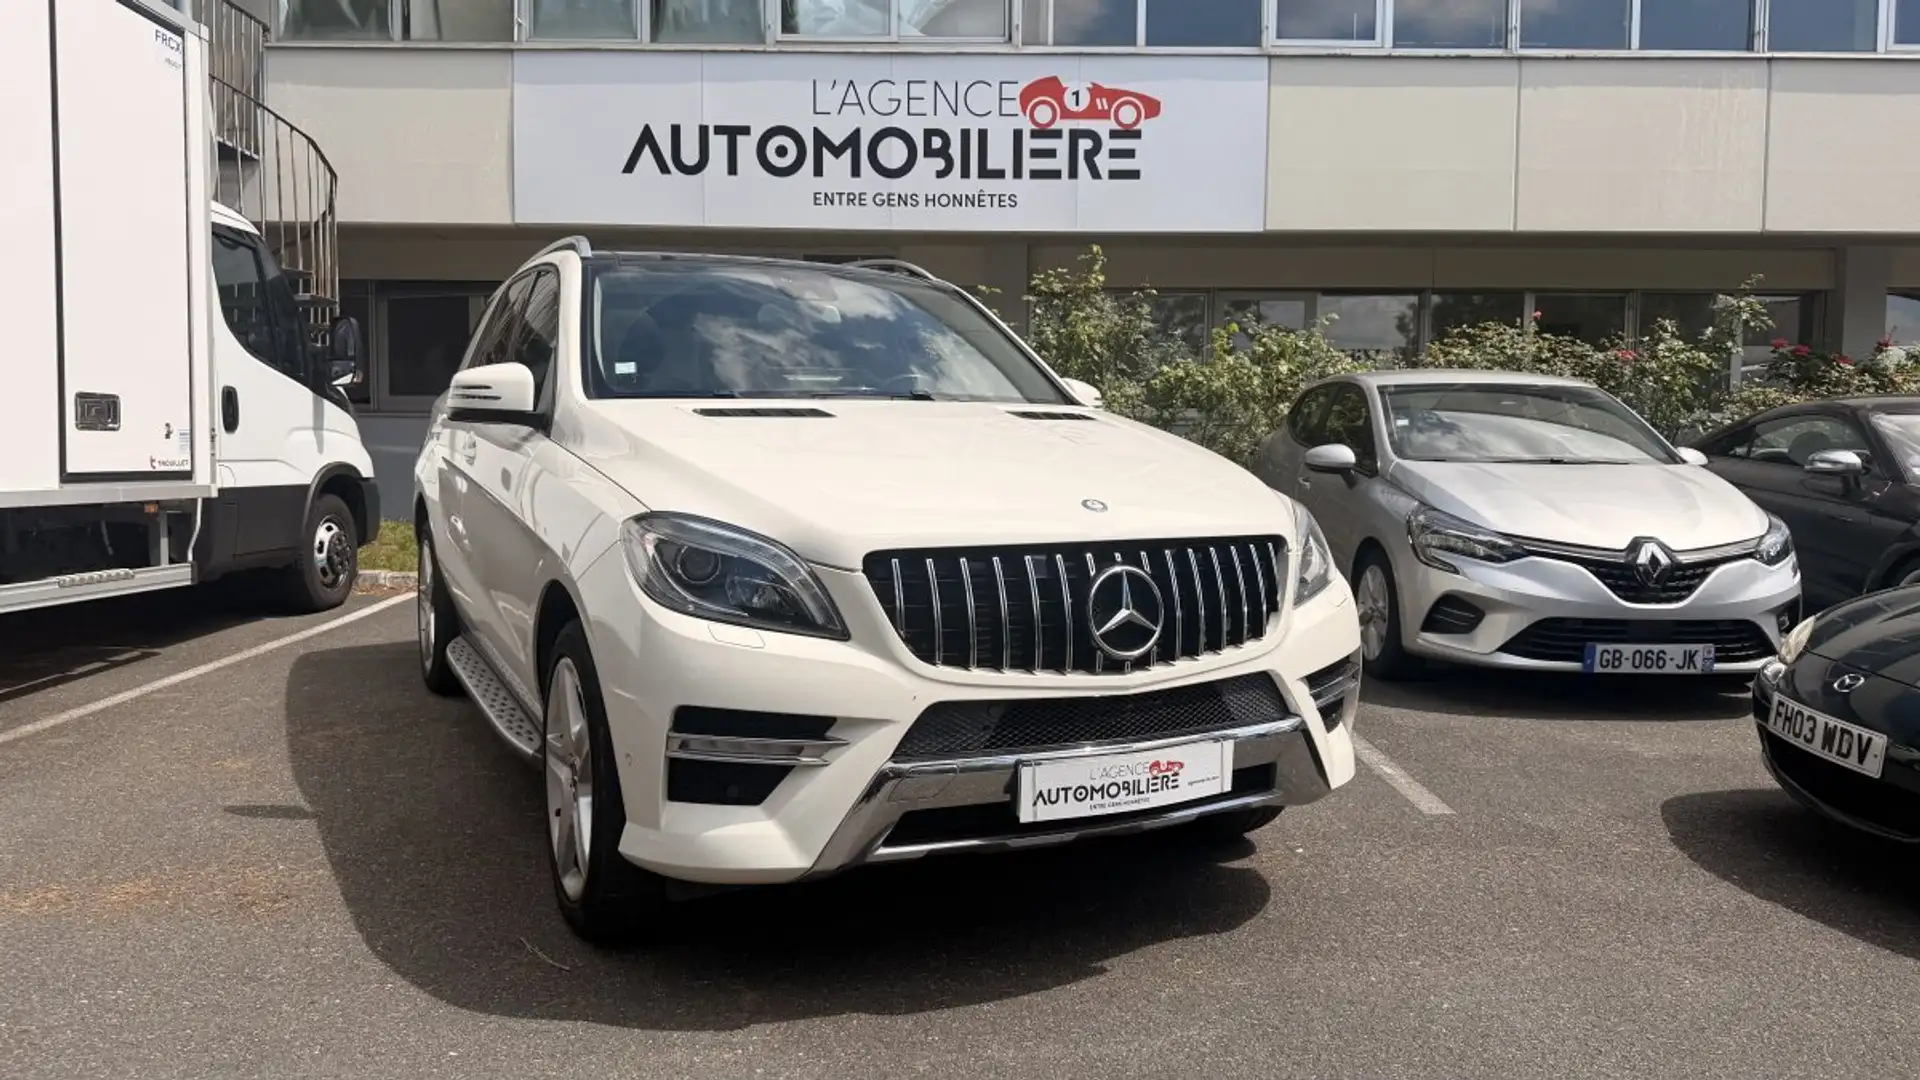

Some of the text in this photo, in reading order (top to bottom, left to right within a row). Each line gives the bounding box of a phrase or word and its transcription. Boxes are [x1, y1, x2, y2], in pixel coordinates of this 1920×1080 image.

[812, 78, 1019, 117] L'AGENCE
[1070, 89, 1081, 106] 1
[813, 189, 1018, 208] ENTRE GENS HONNÊTES
[1599, 649, 1700, 670] GB-066-JK
[1773, 699, 1872, 765] FH03 WDV
[1089, 762, 1150, 780] L'AGENCE
